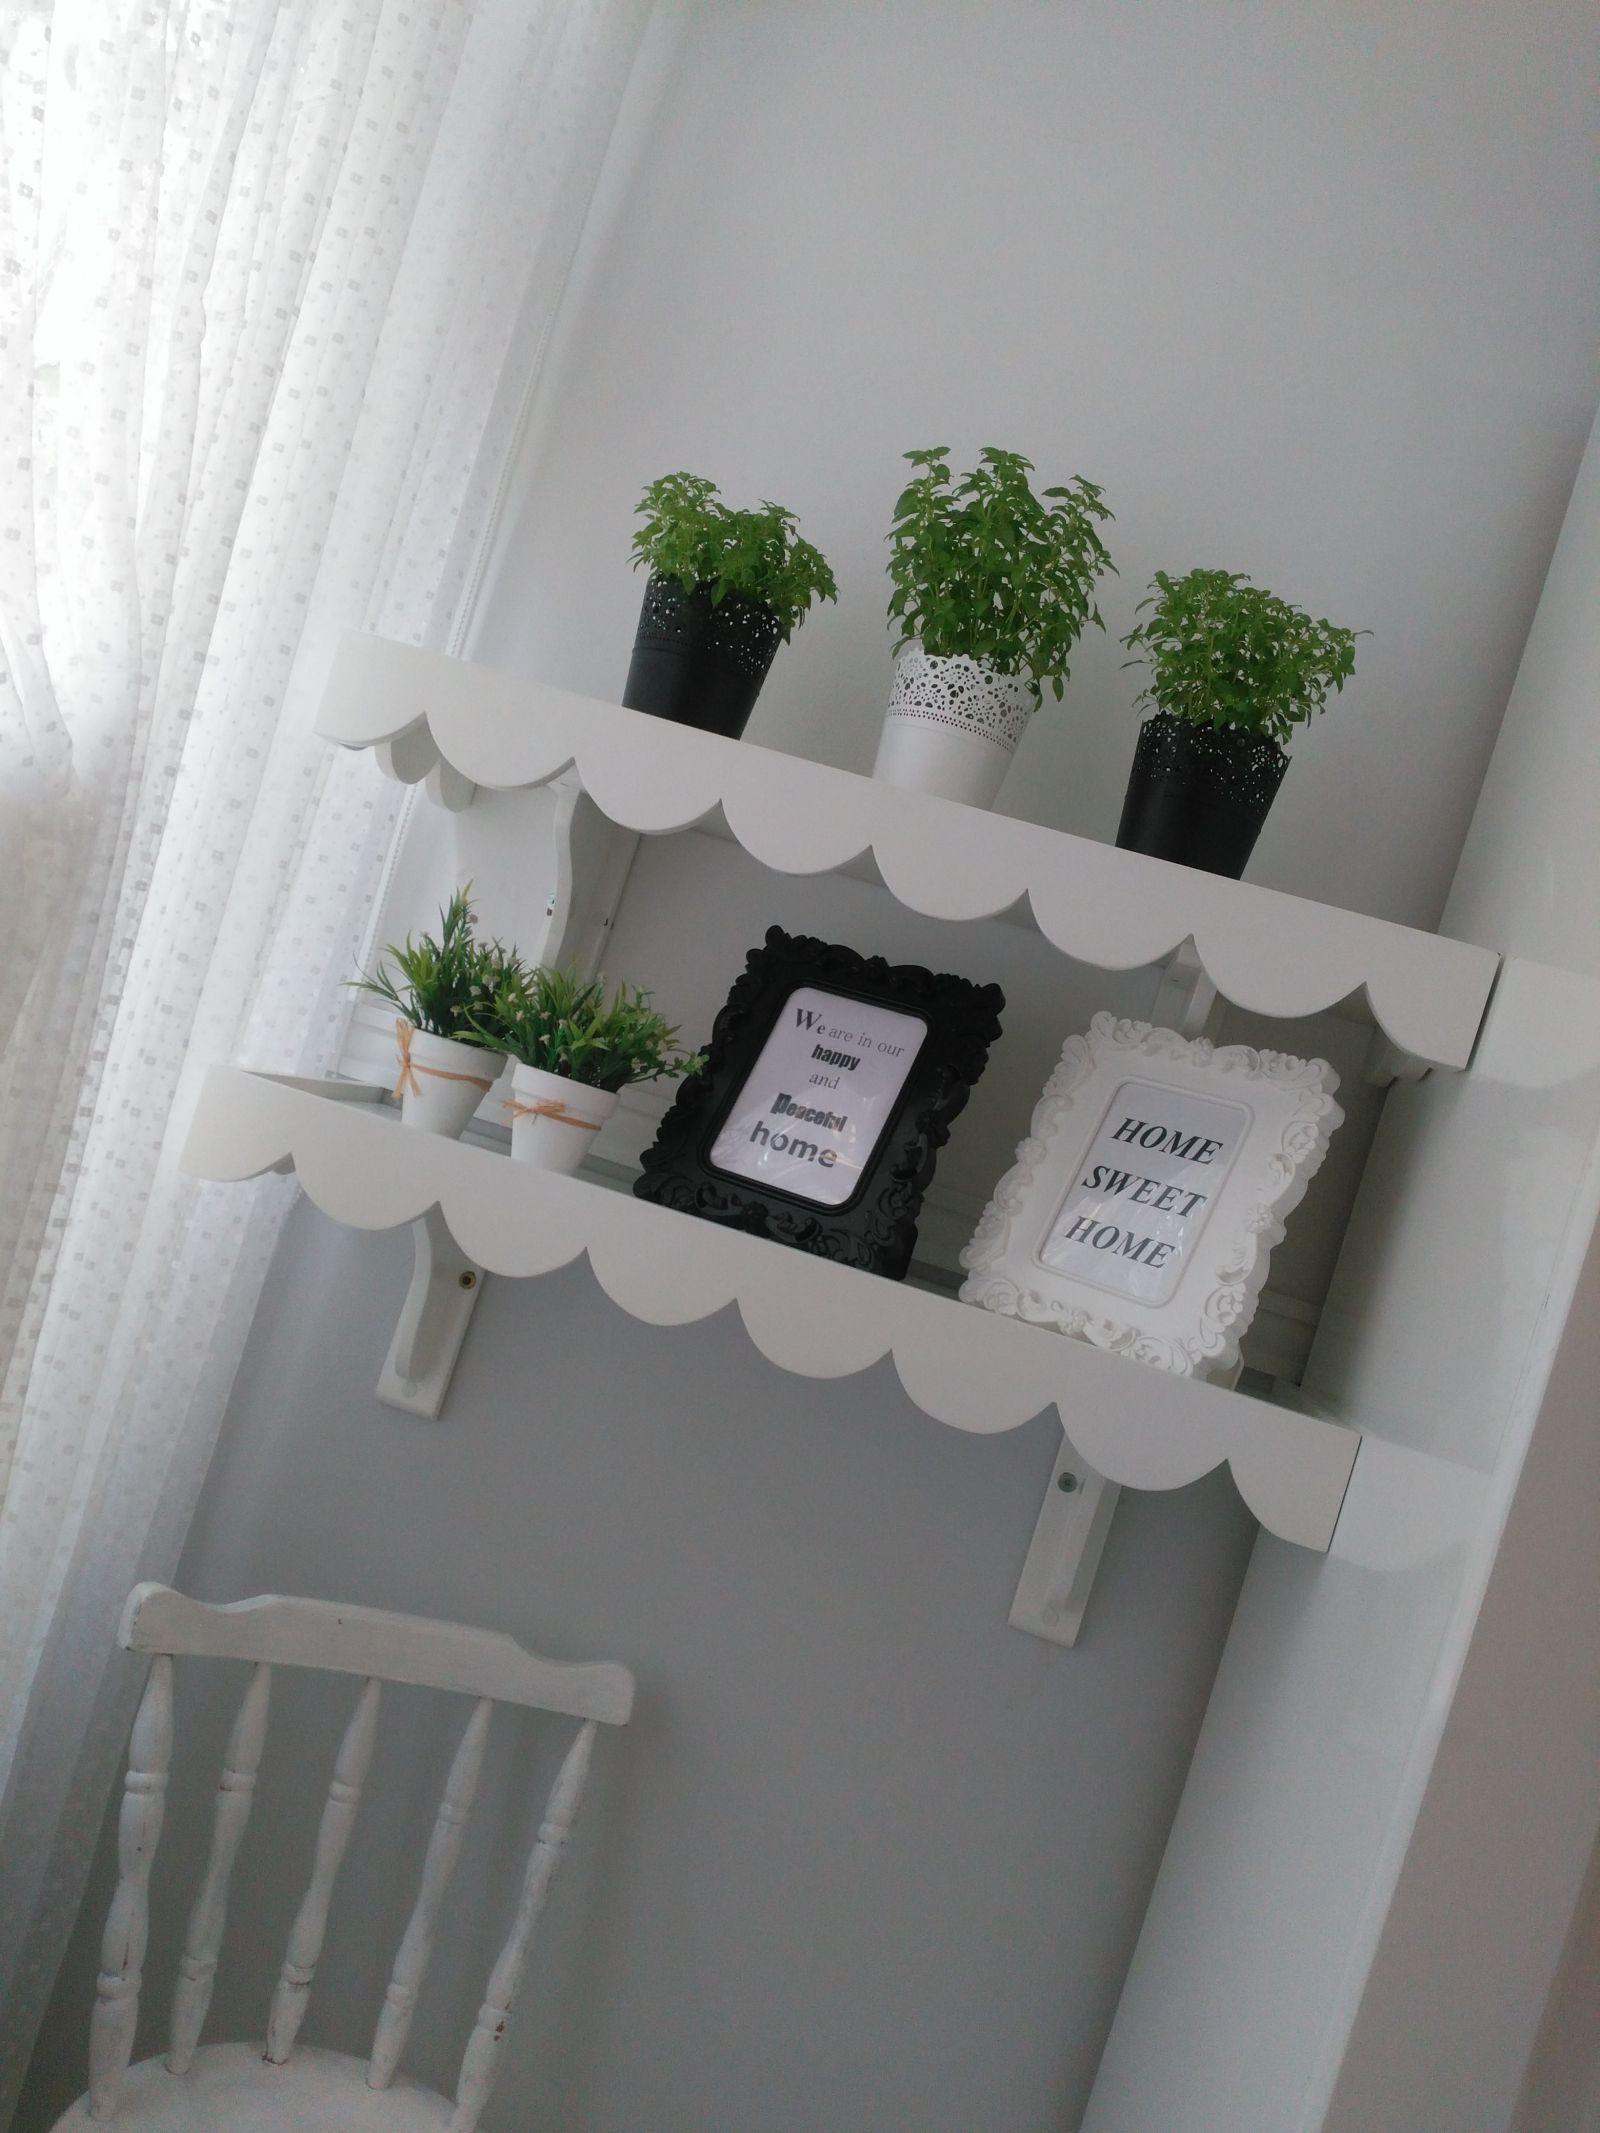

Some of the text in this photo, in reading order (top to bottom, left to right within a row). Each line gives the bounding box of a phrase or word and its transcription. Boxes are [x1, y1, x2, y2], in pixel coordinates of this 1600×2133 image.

[795, 1008, 905, 1057] We are in our
[810, 1043, 861, 1071] happy
[808, 1074, 841, 1090] and
[750, 1121, 838, 1168] home
[1110, 1117, 1223, 1165] HOME
[1081, 1165, 1208, 1218] SWEET
[1064, 1216, 1177, 1269] HOME
